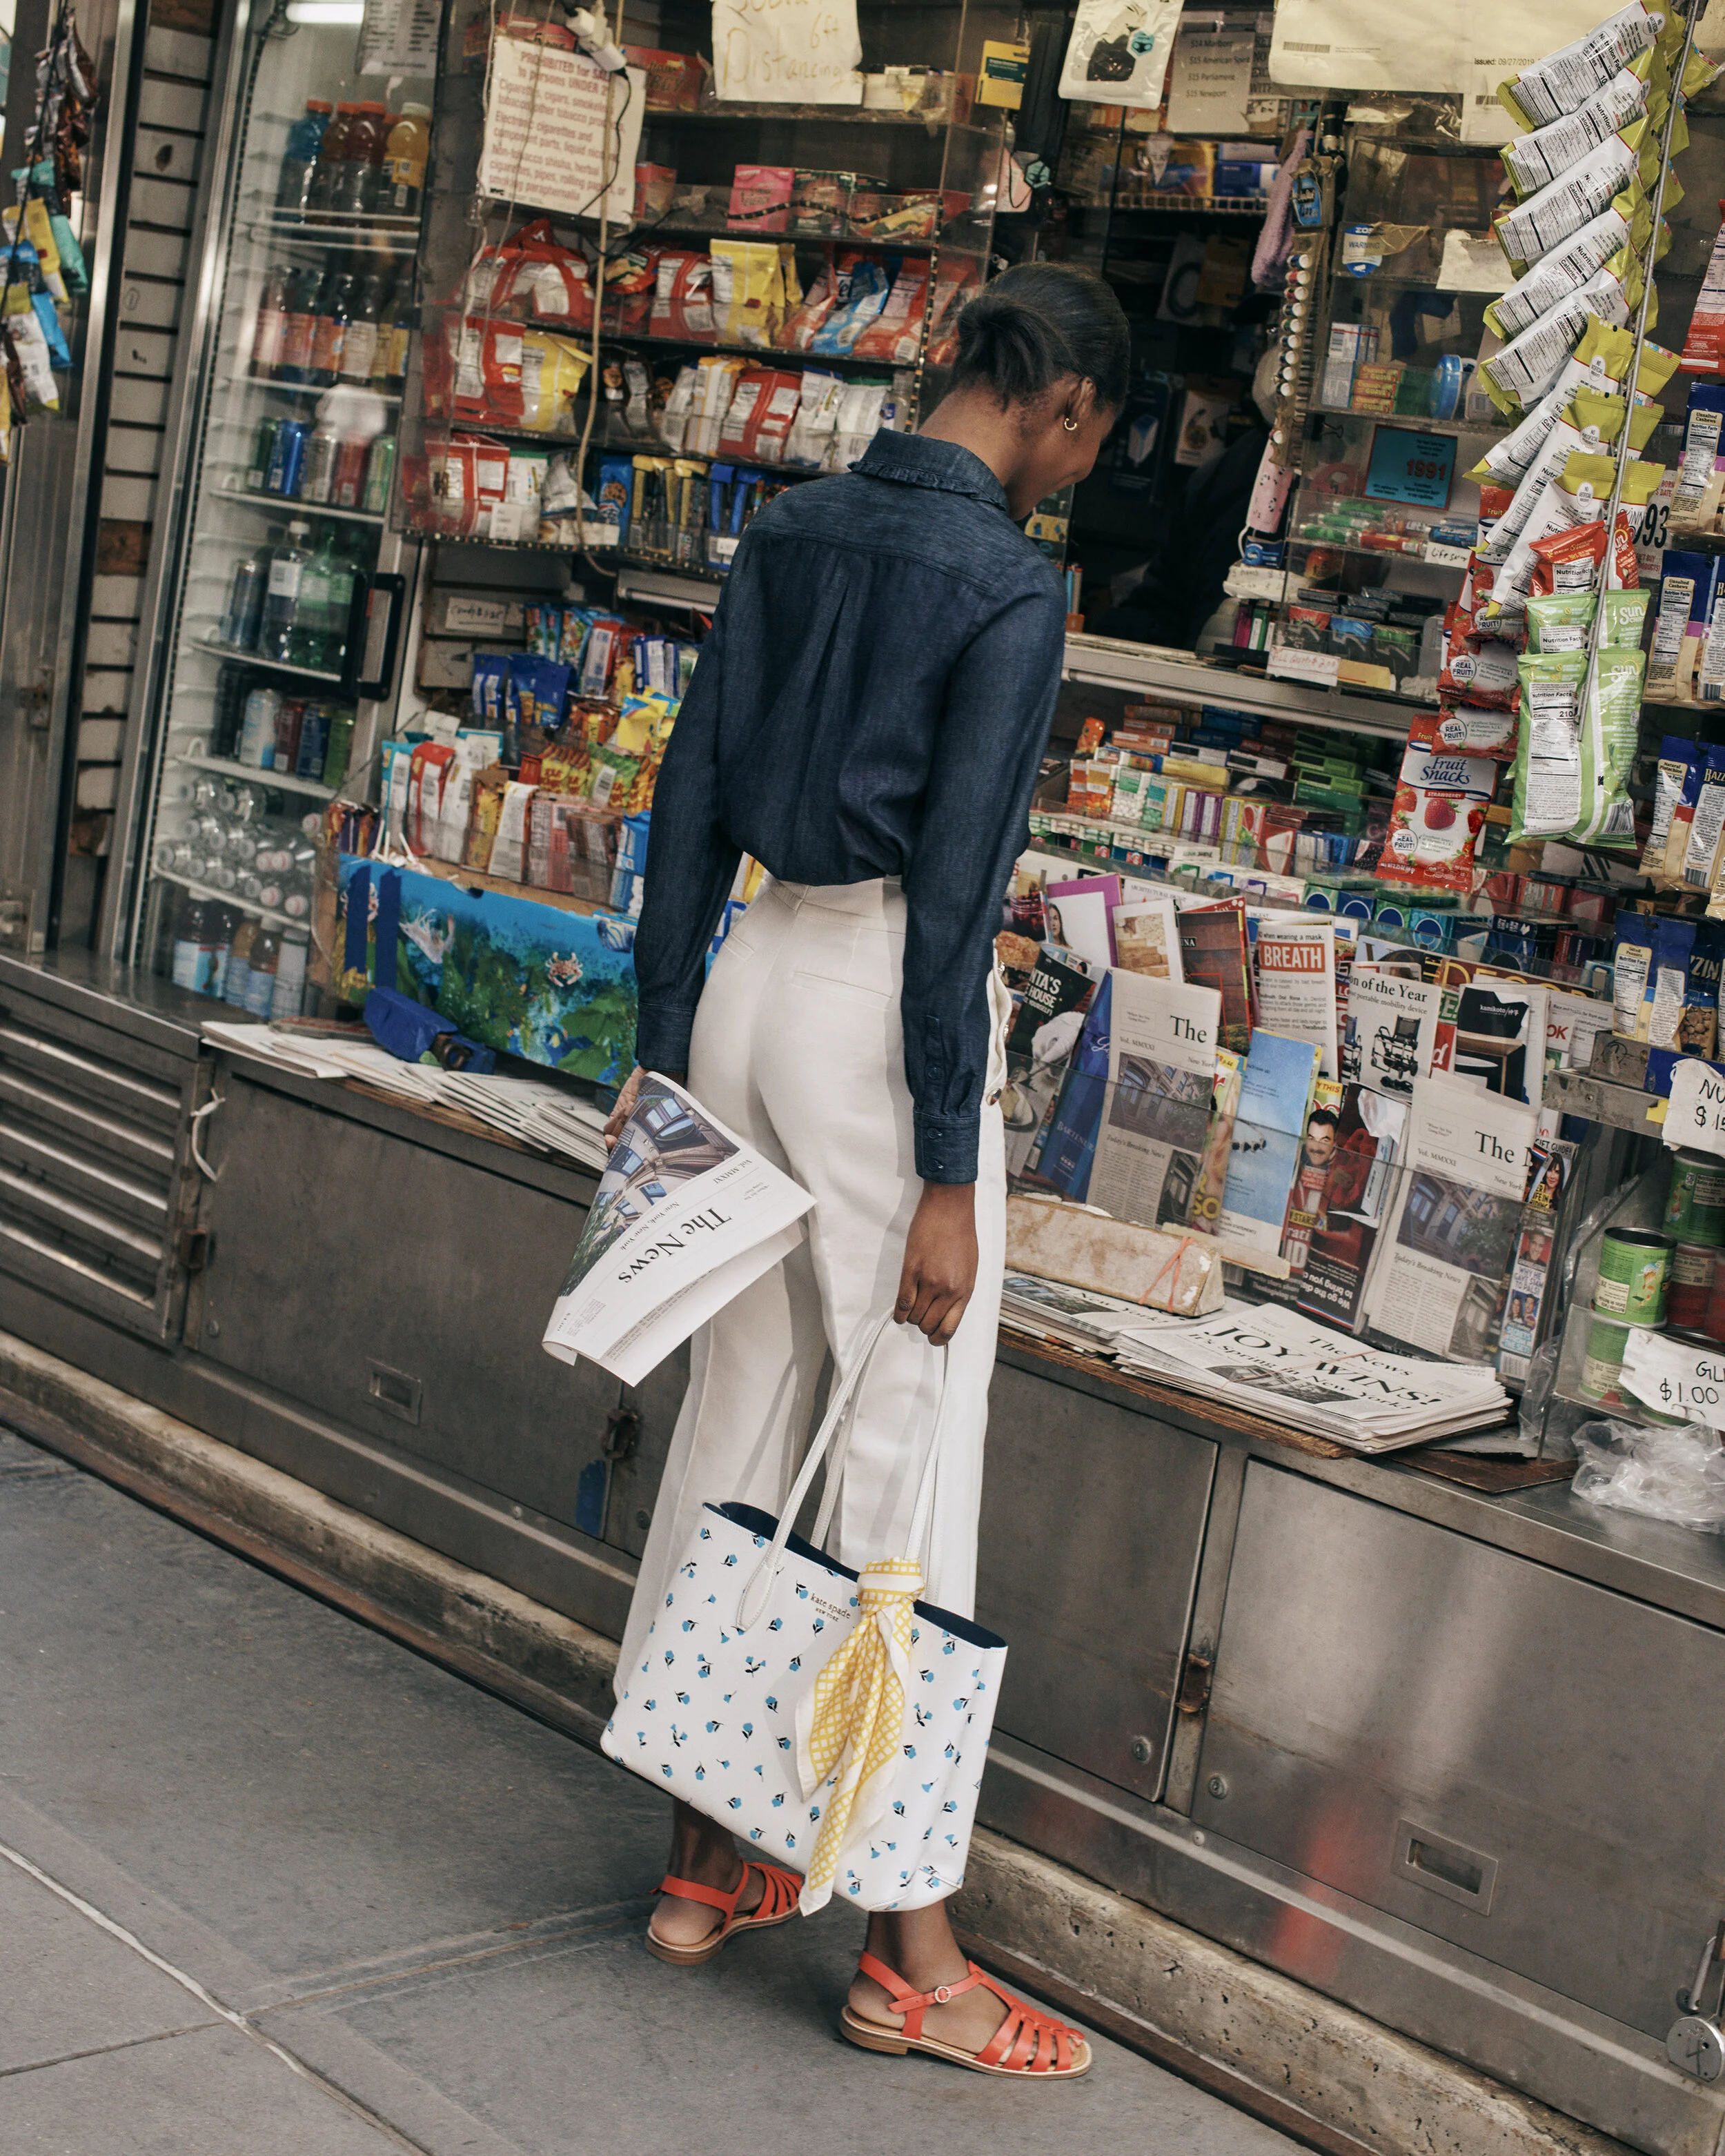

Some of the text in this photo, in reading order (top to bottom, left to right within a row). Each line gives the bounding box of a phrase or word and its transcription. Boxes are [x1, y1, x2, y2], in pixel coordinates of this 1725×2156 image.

[1578, 113, 1593, 136] Calories
[1595, 101, 1613, 130] Nutrition
[1569, 183, 1584, 208] Calories
[1349, 241, 1381, 249] WARNING
[1576, 245, 1597, 271] Nutrition
[1561, 259, 1578, 281] Calories
[1557, 317, 1570, 337] Calories
[1407, 457, 1446, 481] 1991
[1479, 620, 1499, 629] FRUIT!
[1619, 606, 1645, 625] Sun
[1452, 668, 1474, 677] FRUIT!
[1444, 731, 1465, 740] FRUIT!
[1431, 756, 1468, 771] Fruit
[1420, 766, 1471, 785] Snacks
[1394, 841, 1415, 849] FRUIT!
[1276, 933, 1298, 942] wearing
[1264, 945, 1322, 969] BREATH
[1619, 956, 1636, 964] Nutrition
[1027, 986, 1057, 1009] HOUSE
[1361, 978, 1428, 1003] of the Year
[1357, 992, 1428, 1015] portable mobility device
[1480, 1005, 1506, 1013] kamikoto
[1170, 1015, 1208, 1043] The
[1188, 1056, 1199, 1065] New
[1323, 1082, 1340, 1093] THIS
[1475, 1130, 1515, 1164] The
[1535, 1138, 1573, 1156] GIFT GUIDE!
[738, 1159, 753, 1169] Vol.
[1418, 1148, 1457, 1167] Vol. MMXXI
[1494, 1175, 1506, 1185] New
[664, 1201, 680, 1213] New
[634, 1223, 650, 1237] New
[618, 1207, 733, 1284] The News
[620, 1236, 635, 1252] York
[1394, 1252, 1461, 1284] Today's Breaking News
[1309, 1274, 1354, 1299] to bring you
[1314, 1287, 1350, 1309] We go the
[1307, 1335, 1413, 1376] The News
[1204, 1327, 1442, 1406] JOY WINS!
[1218, 1345, 1277, 1369] Spring
[1281, 1367, 1300, 1376] in
[1304, 1374, 1351, 1392] New
[1359, 1390, 1412, 1410] York!
[1659, 1377, 1719, 1405] $1.00
[811, 1592, 851, 1620] kate spade
[816, 1607, 826, 1615] NEW
